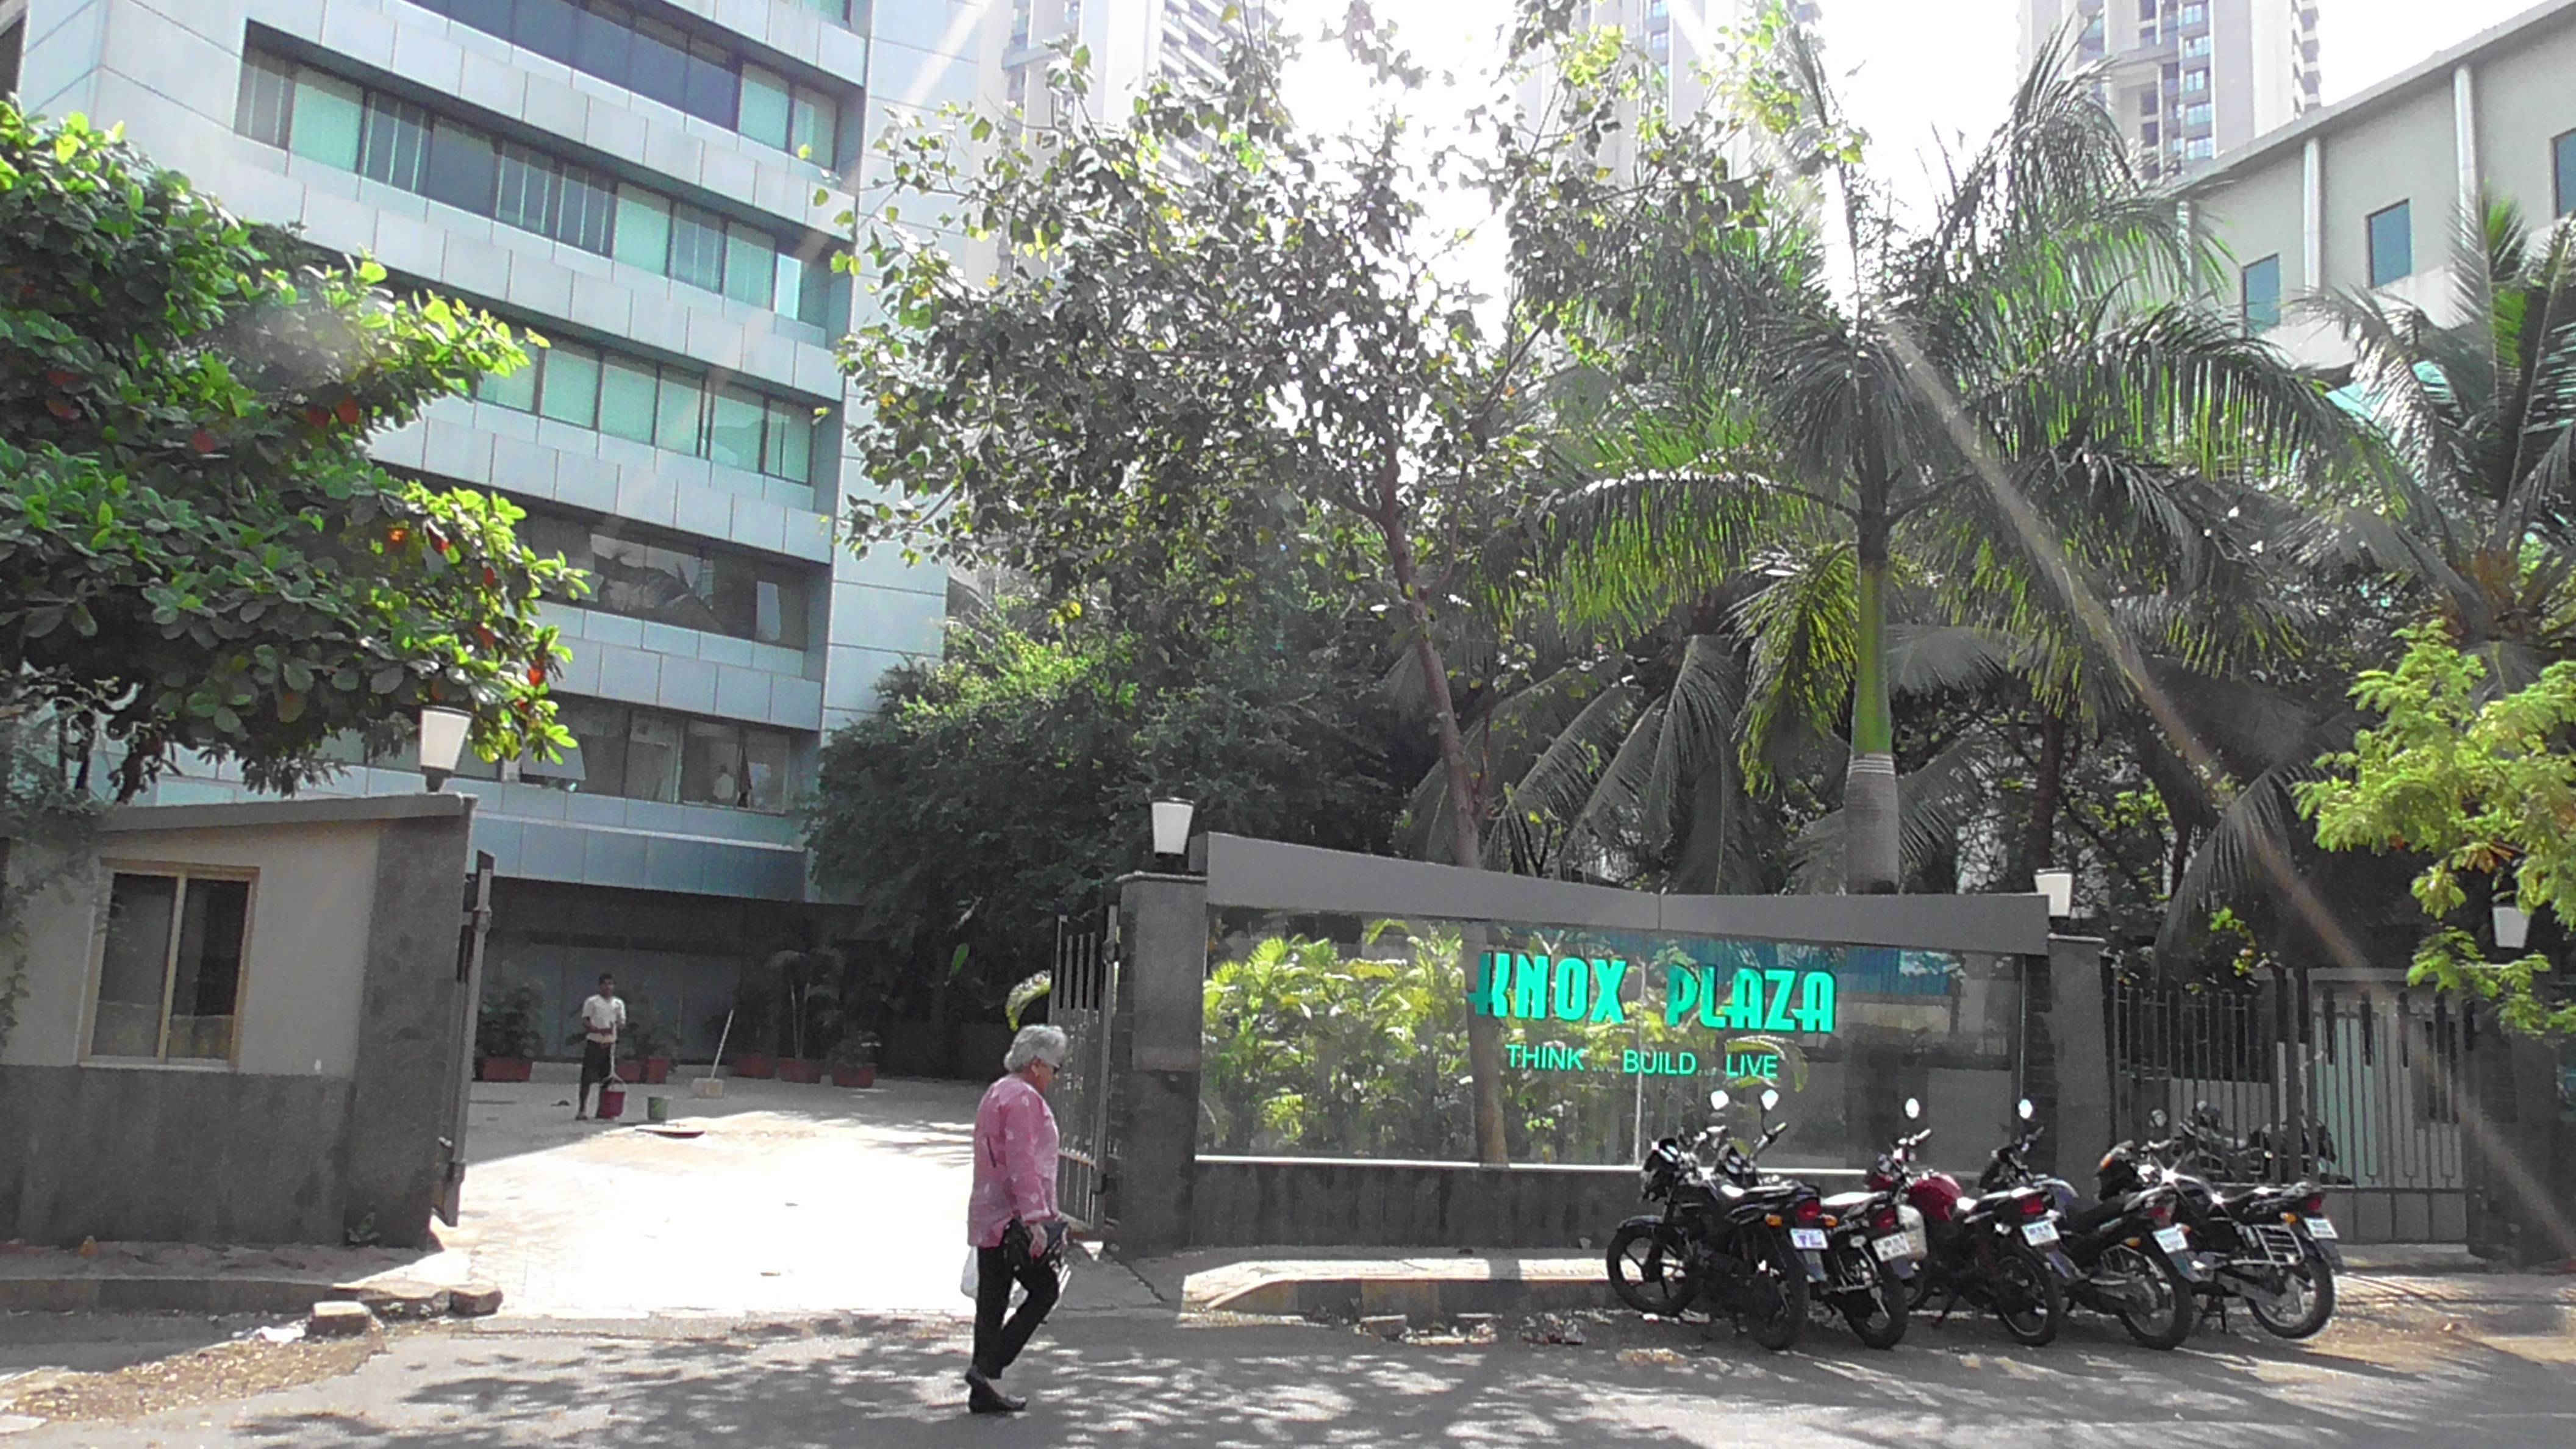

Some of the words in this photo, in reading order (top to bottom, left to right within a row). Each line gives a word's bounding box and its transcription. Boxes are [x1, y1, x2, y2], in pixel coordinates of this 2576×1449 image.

[1467, 952, 1627, 1024] KNOX
[1665, 964, 1836, 1032] PLAZA
[1505, 1044, 1585, 1070] THINK
[1623, 1050, 1697, 1075] BUILD
[1726, 1054, 1778, 1079] LIVE
